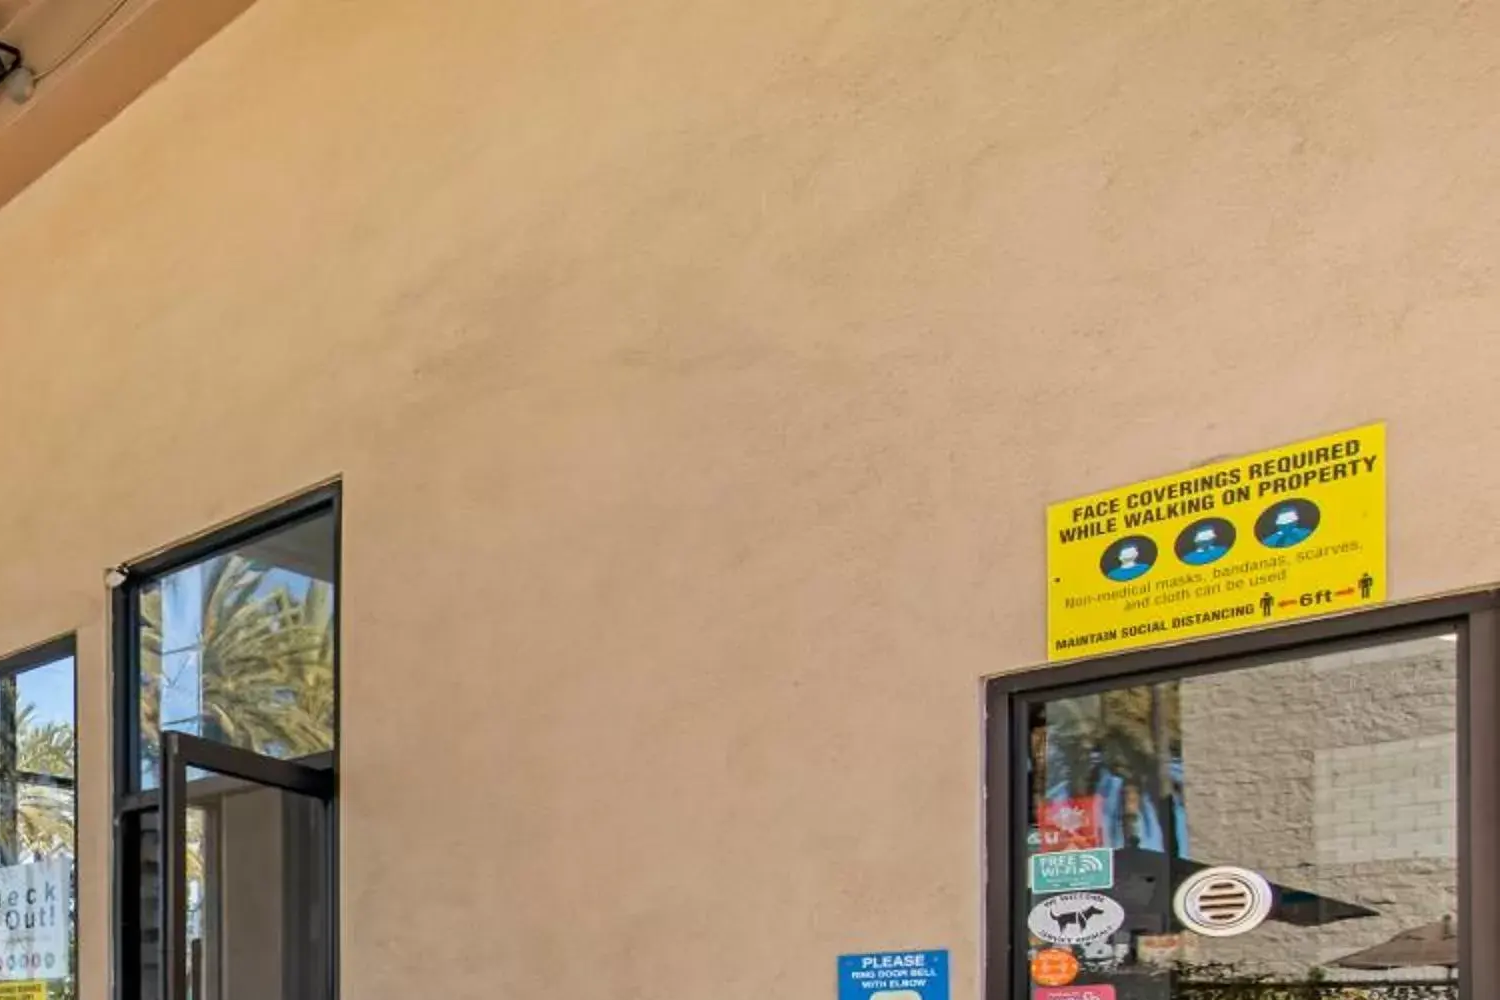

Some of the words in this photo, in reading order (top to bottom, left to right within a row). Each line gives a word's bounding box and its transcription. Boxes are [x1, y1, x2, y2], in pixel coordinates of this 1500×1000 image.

[1072, 497, 1120, 522] FACE
[1126, 469, 1241, 509] COVERINGS
[1249, 439, 1360, 480] REQUIRED
[1059, 517, 1117, 544] WHILE
[1124, 494, 1215, 528] WALKING
[1222, 486, 1250, 505] ON
[1258, 455, 1377, 497] PROPERTY
[1065, 581, 1151, 609] Non-medical
[1195, 582, 1221, 597] can
[1226, 578, 1245, 592] be
[1250, 569, 1287, 586] used
[1055, 629, 1117, 650] MAINTAIN
[1121, 619, 1168, 640] SOCIAL
[1171, 603, 1255, 629] DISTANCING
[1300, 589, 1332, 607] 6ft
[5, 904, 56, 931] Out!
[851, 970, 877, 979] RING
[878, 969, 909, 979] DOOR
[910, 967, 938, 977] BELL
[862, 953, 925, 969] PLEASE
[861, 980, 888, 989] WITH
[889, 978, 928, 989] ELBOW
